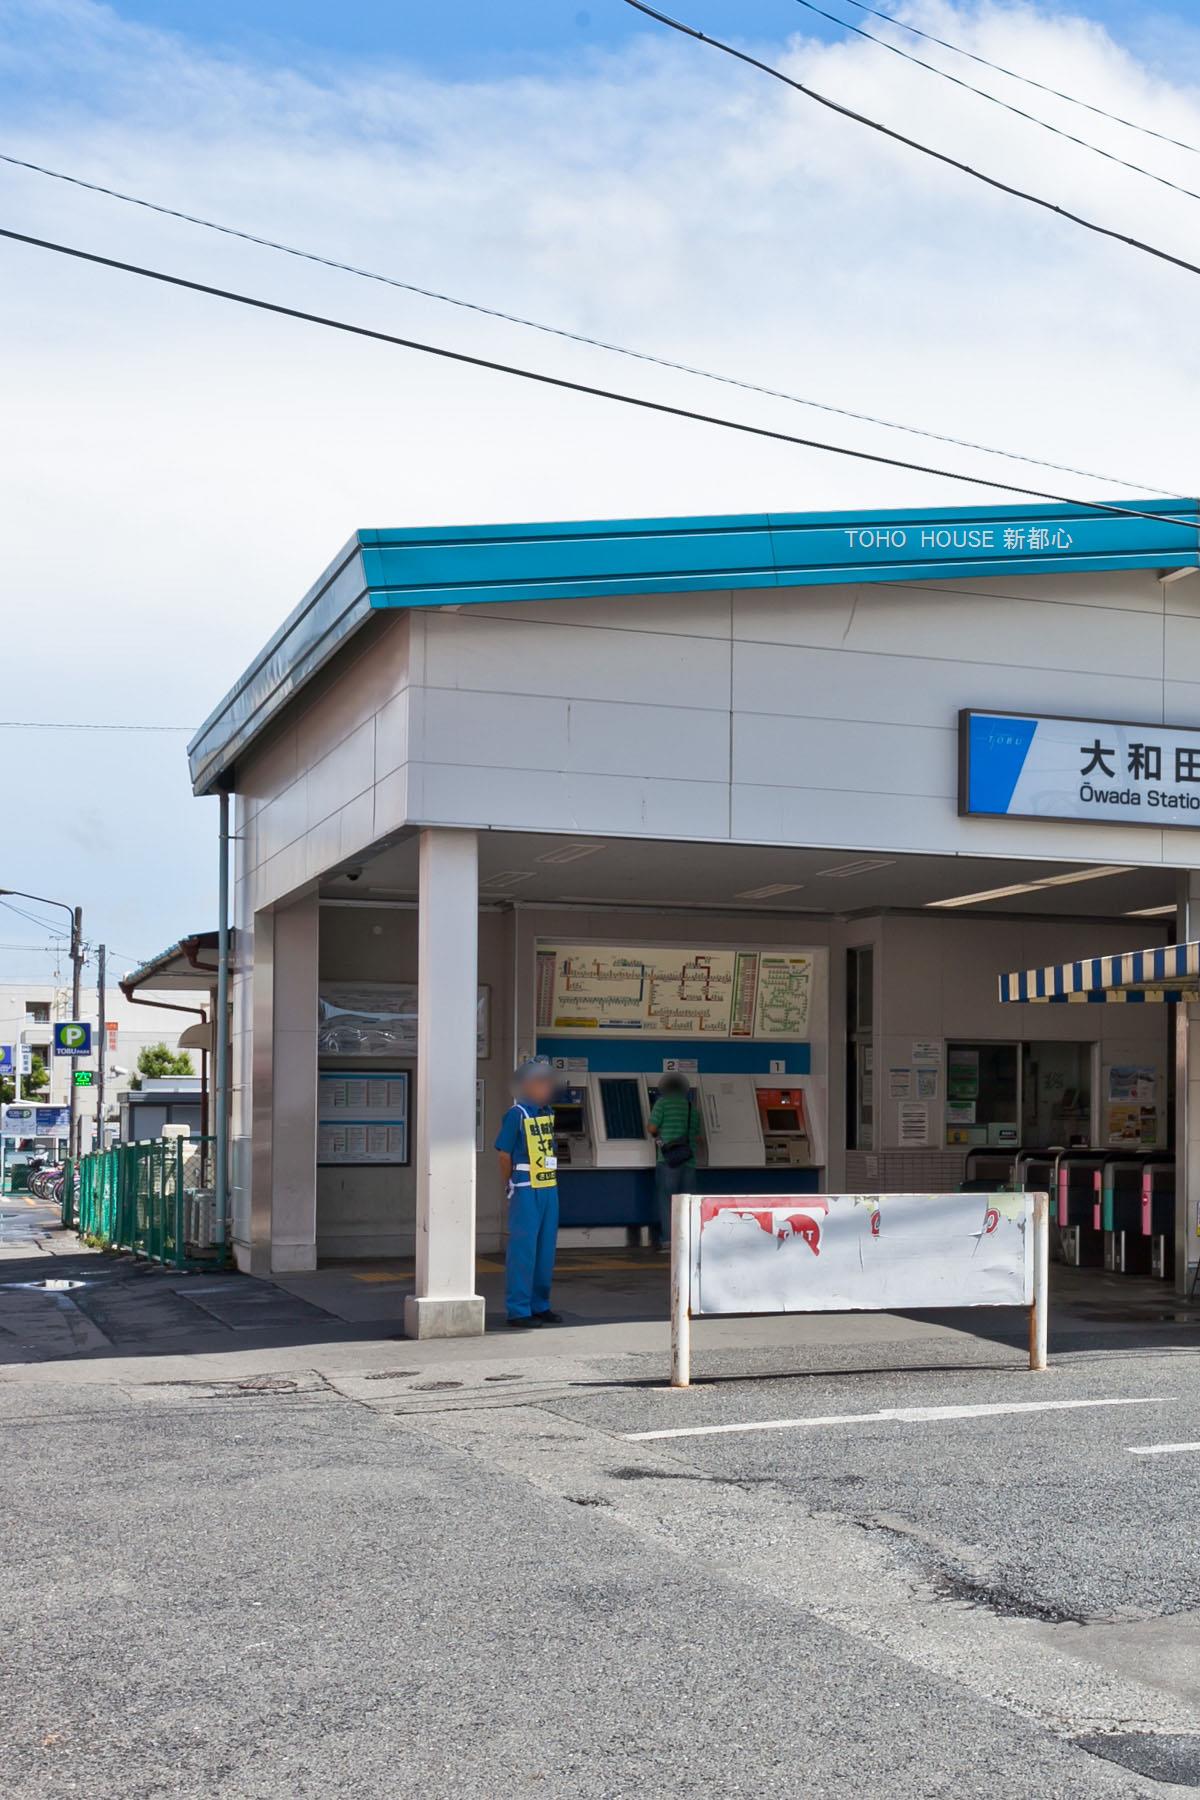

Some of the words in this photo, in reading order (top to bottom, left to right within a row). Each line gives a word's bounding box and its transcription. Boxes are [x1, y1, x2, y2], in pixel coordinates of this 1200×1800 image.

[844, 530, 907, 548] TOHO
[921, 530, 994, 548] HOUSE
[1003, 527, 1073, 550] 新都心
[1080, 782, 1141, 806] Ōwada
[66, 1028, 82, 1045] P
[556, 1059, 564, 1069] 3
[667, 1061, 675, 1071] 2
[775, 1062, 780, 1072] 1
